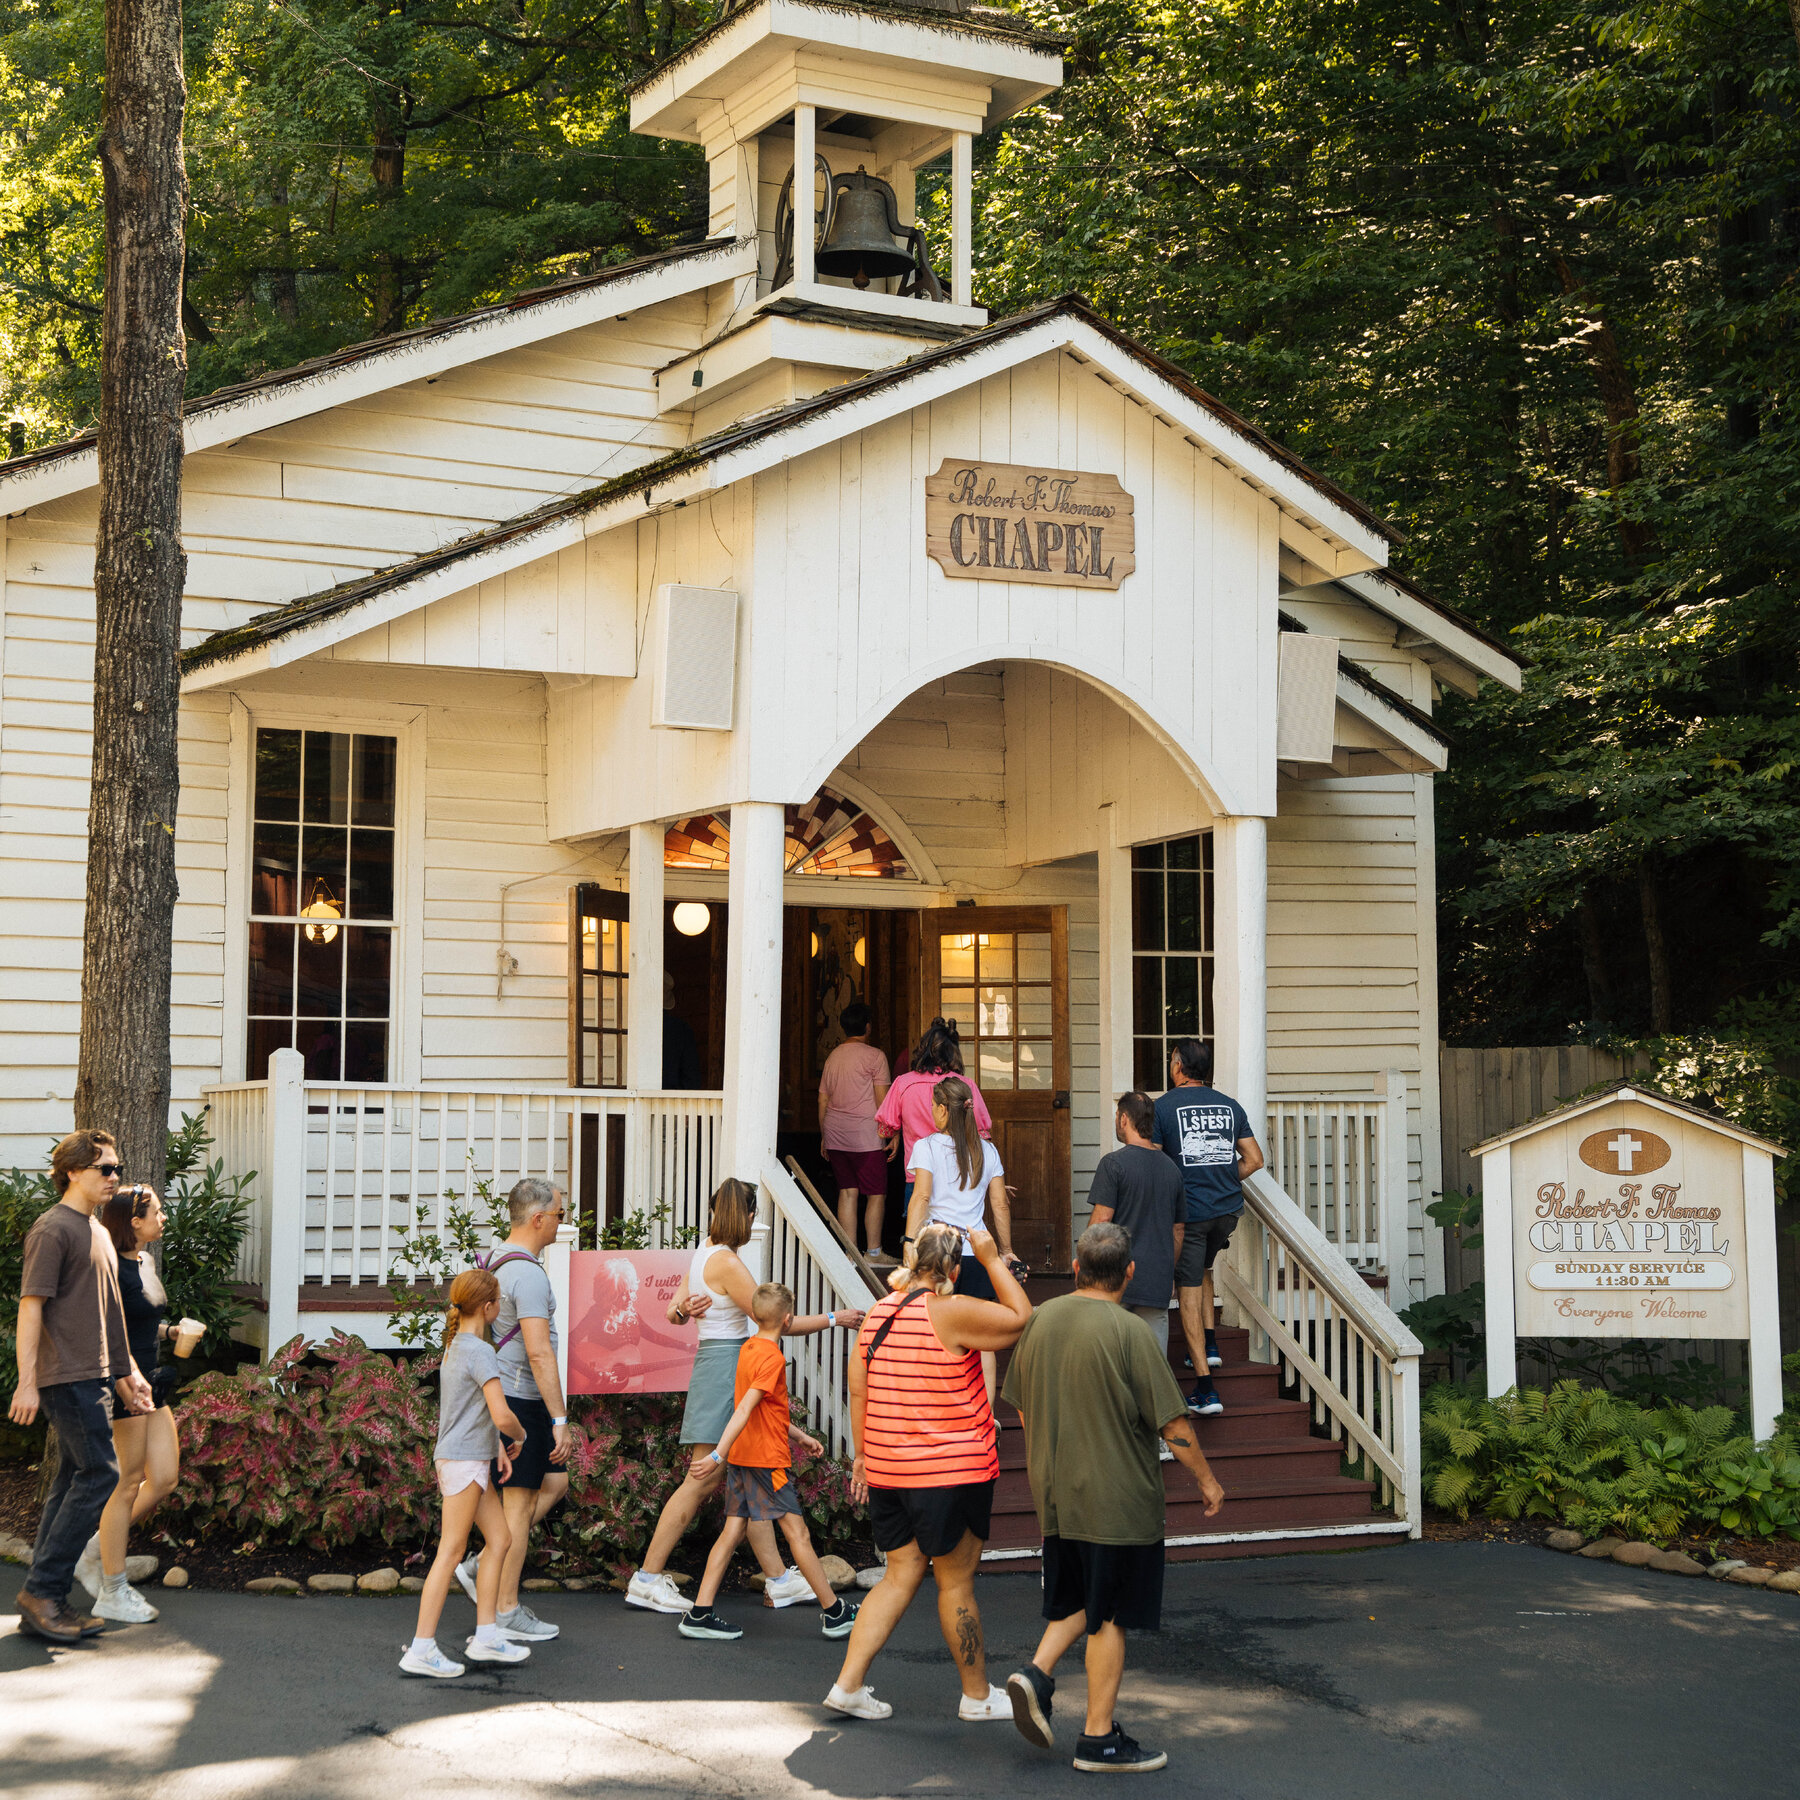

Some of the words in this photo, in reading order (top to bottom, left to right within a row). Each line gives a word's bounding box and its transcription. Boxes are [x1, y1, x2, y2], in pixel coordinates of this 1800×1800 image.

[949, 467, 1022, 508] Robert
[1021, 475, 1047, 511] F.
[1043, 476, 1115, 518] Thomas
[950, 512, 1115, 581] CHAPEL
[1182, 1109, 1230, 1117] HOLLEY
[1536, 1181, 1618, 1219] Robert
[1616, 1183, 1642, 1219] F.
[1645, 1183, 1721, 1221] Thomas
[1529, 1220, 1729, 1256] CHAPEL
[645, 1274, 654, 1288] I
[655, 1274, 682, 1288] will
[1555, 1263, 1625, 1274] SUNDAY
[1629, 1263, 1705, 1274] SERVICE
[1595, 1276, 1640, 1286] 11:30
[1644, 1276, 1671, 1286] AM
[1554, 1297, 1633, 1326] Everyone
[1641, 1297, 1708, 1319] Welcome
